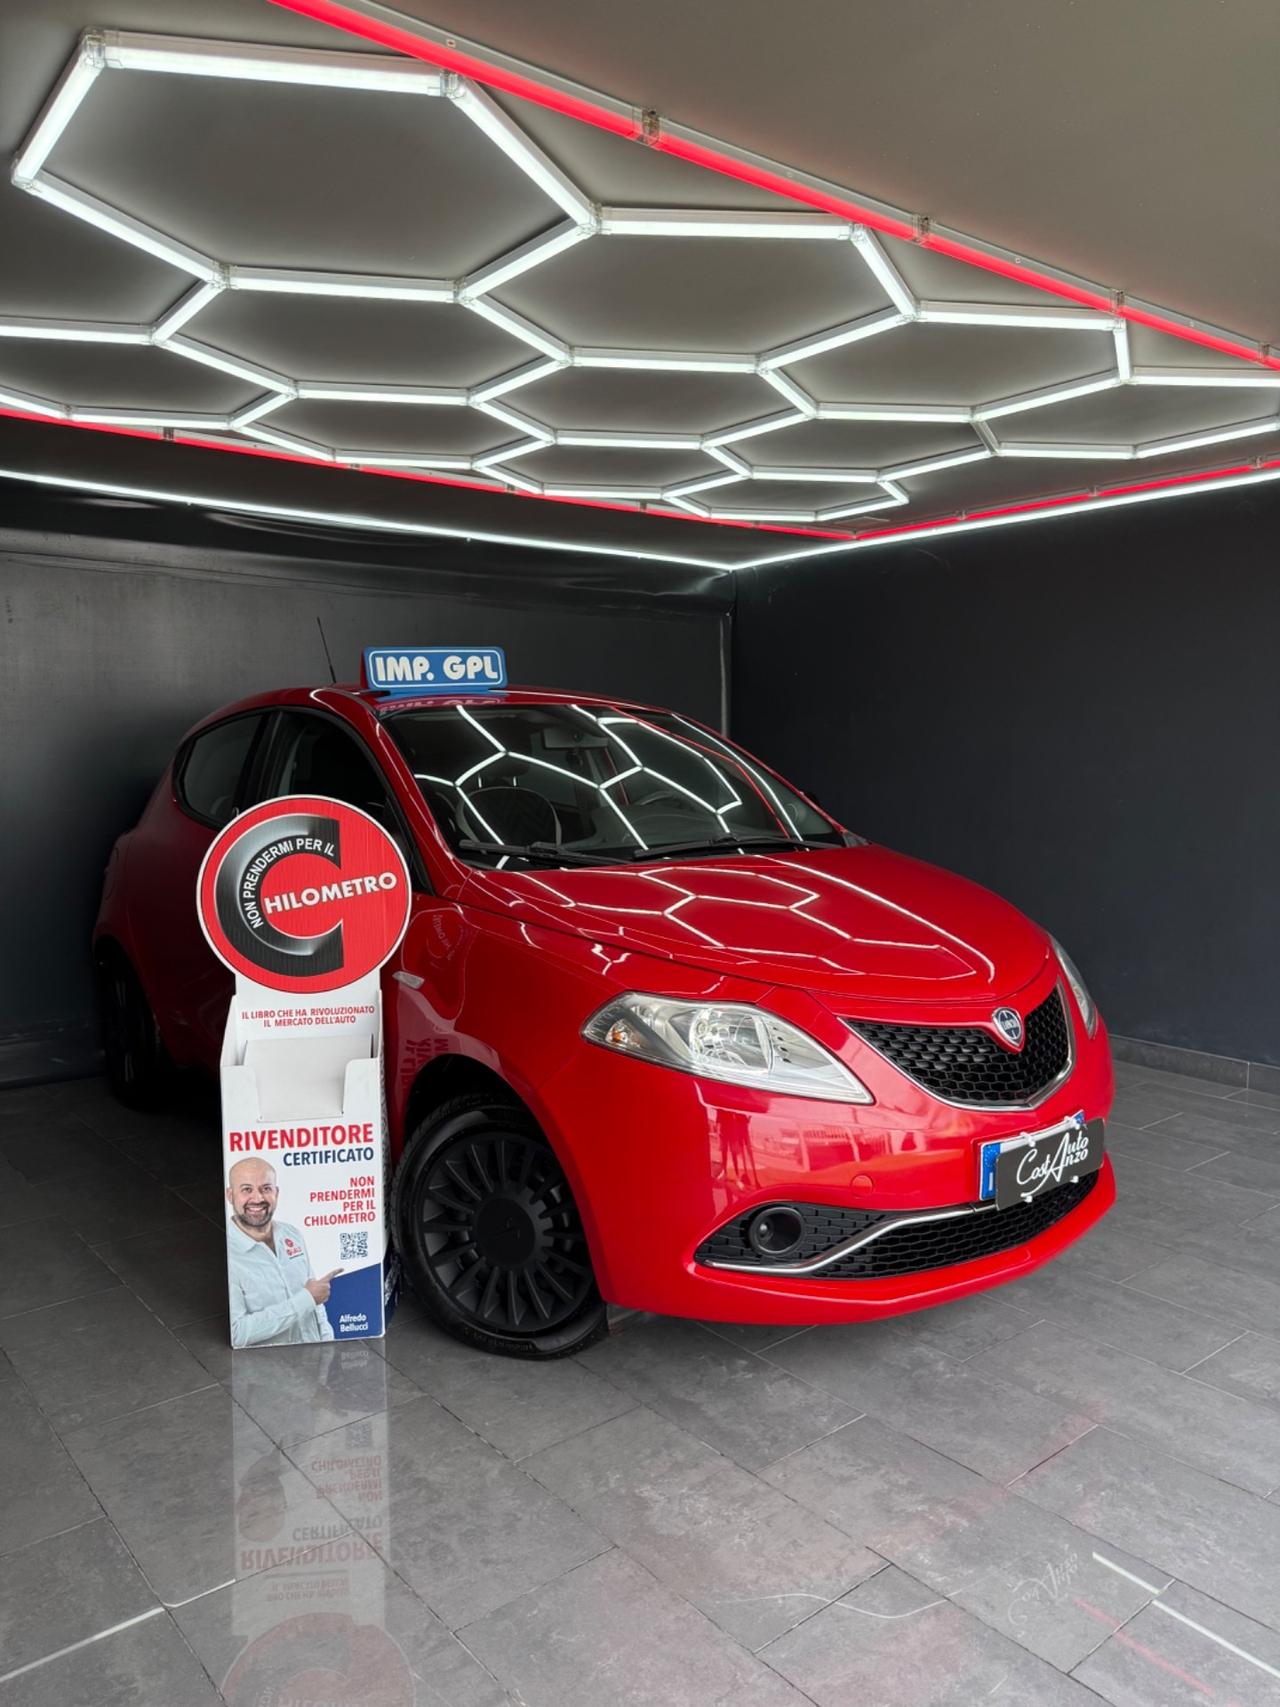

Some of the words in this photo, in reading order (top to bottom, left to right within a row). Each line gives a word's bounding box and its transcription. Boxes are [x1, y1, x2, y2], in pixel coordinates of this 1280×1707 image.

[375, 656, 435, 681] IMP.
[443, 655, 498, 680] GPL
[296, 838, 323, 851] PER
[324, 843, 335, 857] IL
[244, 840, 294, 899] PRENDERMI
[244, 901, 264, 929] NON
[242, 1012, 249, 1020] IL
[251, 1010, 276, 1019] LIBRO
[277, 1009, 293, 1018] CHE
[295, 1008, 307, 1017] HA
[310, 1006, 375, 1016] RIVOLUZIONATO
[263, 1019, 271, 1028] IL
[275, 1018, 313, 1027] MERCATO
[315, 1015, 356, 1025] DELL'AUTO
[229, 1123, 374, 1152] RIVENDITORE
[283, 1147, 374, 1166] CERTIFICATO
[350, 1175, 375, 1187] NON
[310, 1187, 375, 1202] PRENDERMI
[343, 1202, 365, 1212] PER
[366, 1200, 376, 1210] IL
[304, 1211, 376, 1227] CHILOMETRO
[339, 1313, 367, 1323] Alfredo
[340, 1323, 368, 1333] Bellucci
